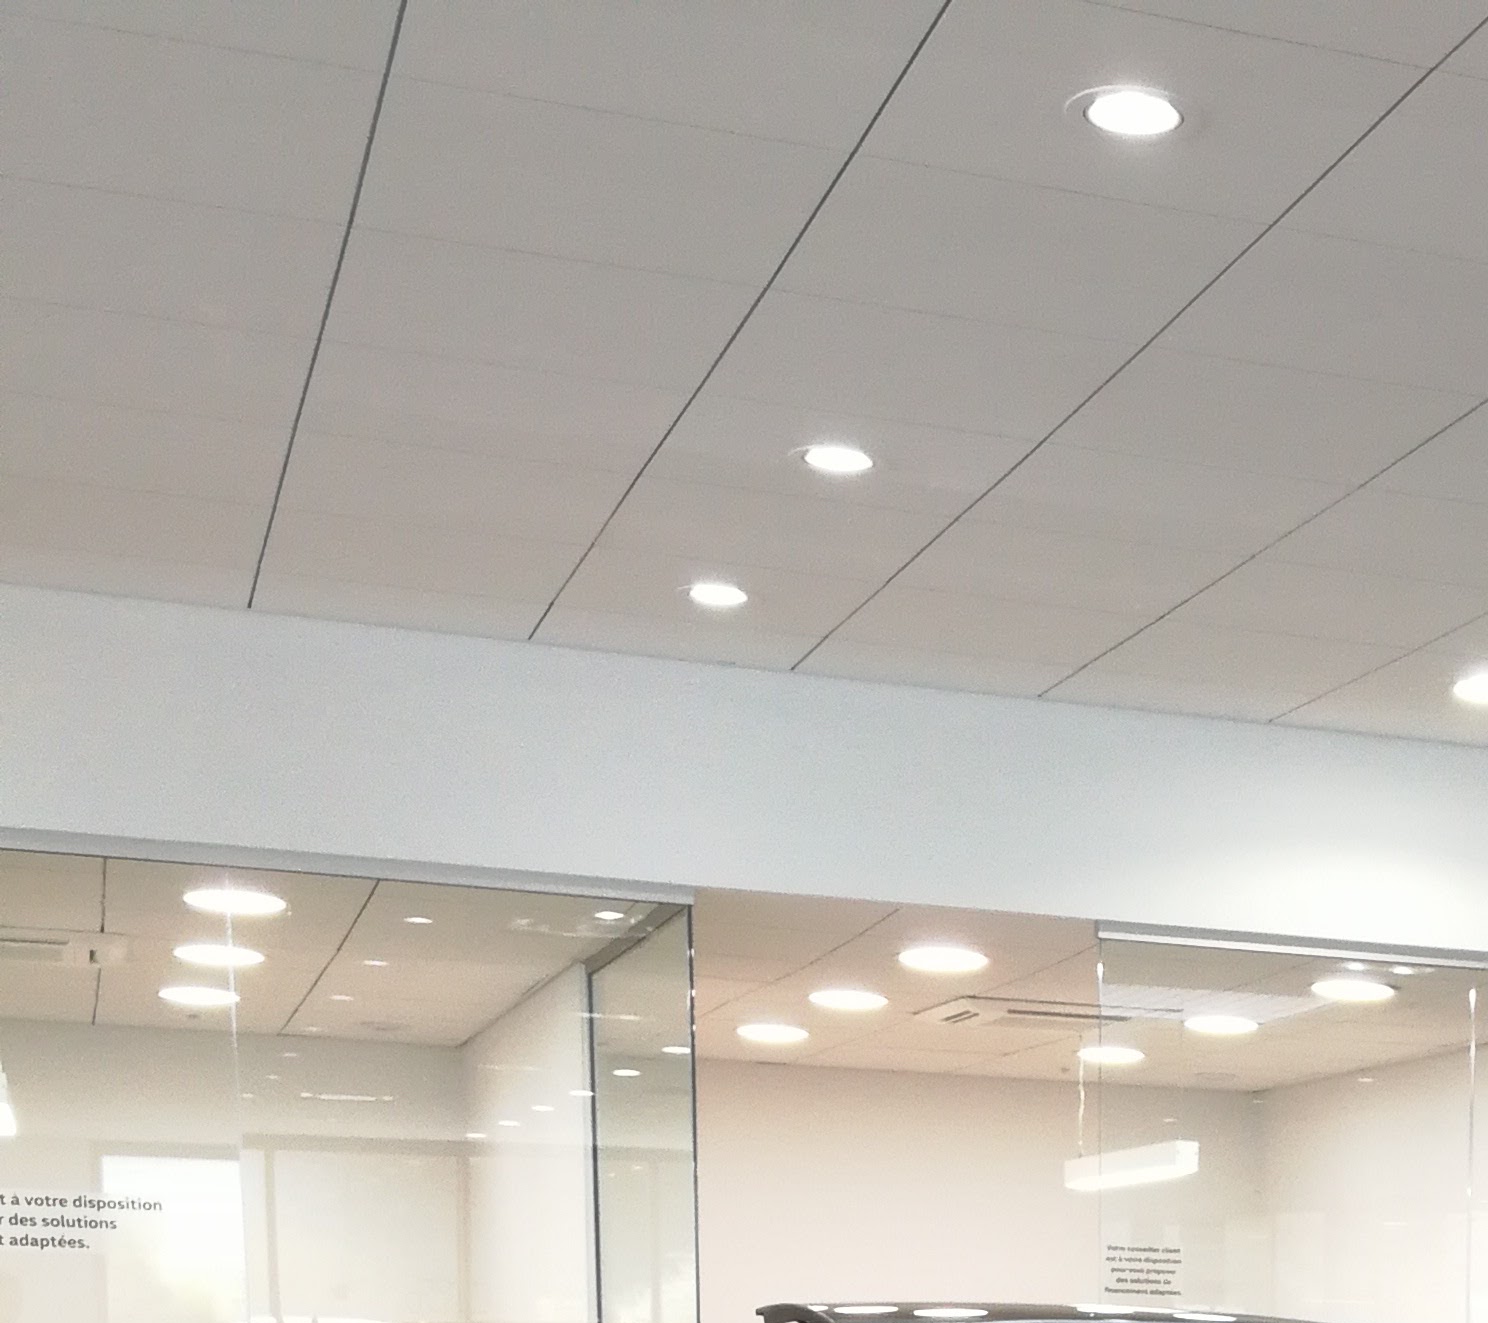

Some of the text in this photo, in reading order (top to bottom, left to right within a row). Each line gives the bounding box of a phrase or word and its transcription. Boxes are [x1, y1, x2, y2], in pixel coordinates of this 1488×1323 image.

[10, 1193, 20, 1205] à
[25, 1195, 68, 1207] votre
[73, 1195, 163, 1212] disposition
[8, 1213, 37, 1227] des
[42, 1215, 117, 1229] solutions
[9, 1234, 90, 1250] adaptées.
